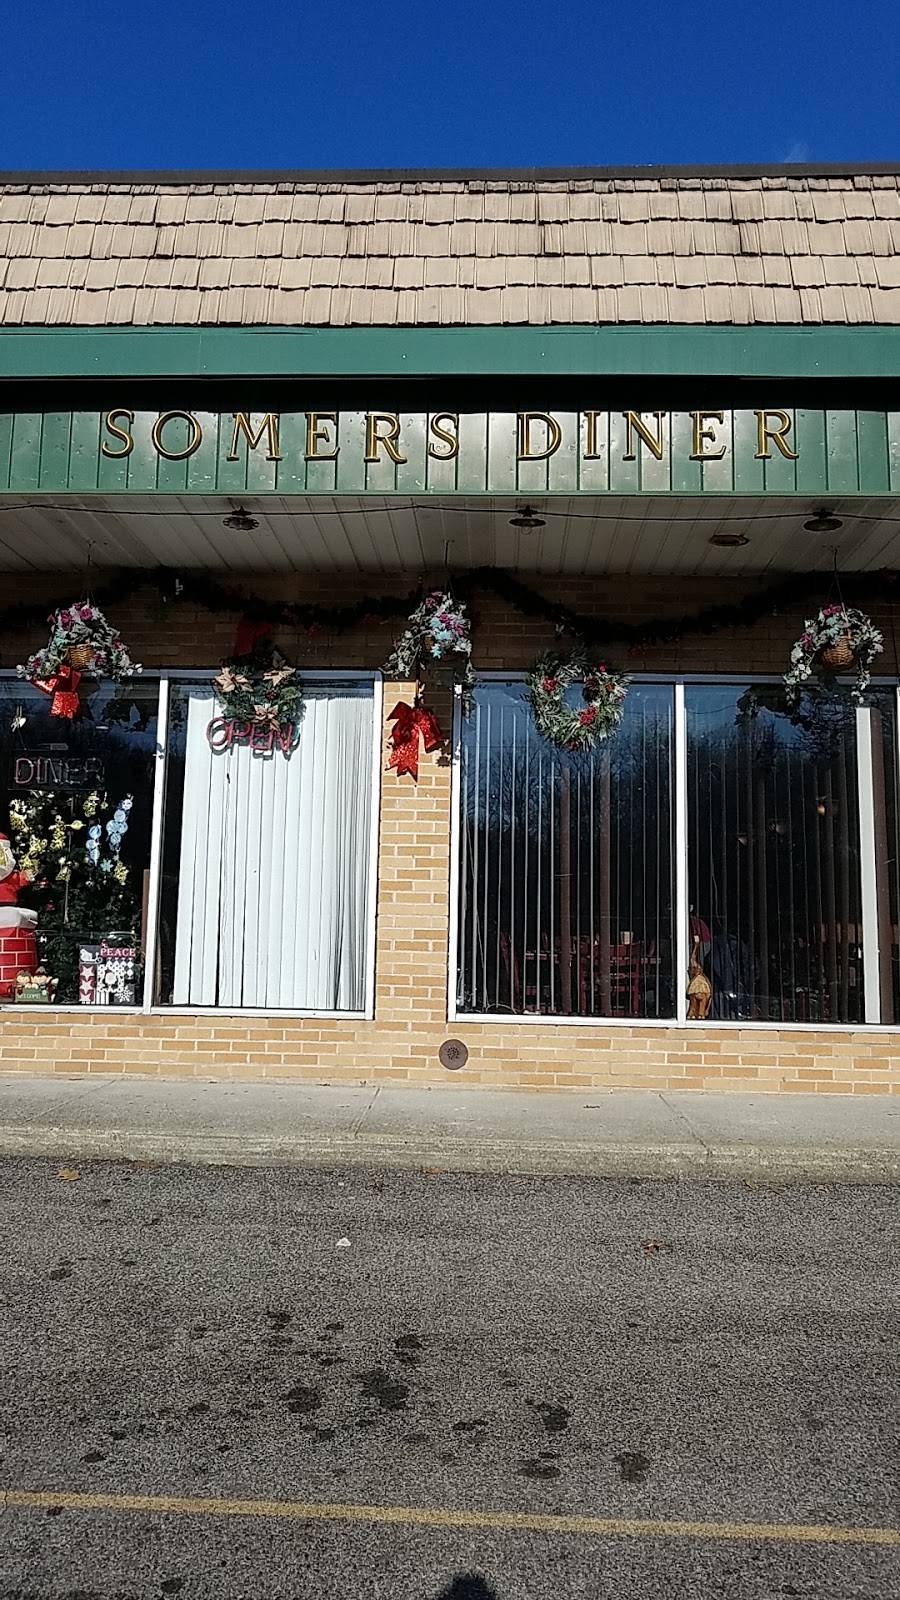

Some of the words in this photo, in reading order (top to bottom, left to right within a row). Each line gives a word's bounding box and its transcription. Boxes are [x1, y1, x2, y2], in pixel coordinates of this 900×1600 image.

[101, 408, 460, 463] SOMERS
[516, 409, 800, 461] DINER
[206, 716, 293, 752] OPEN
[15, 757, 105, 784] DINER
[100, 947, 136, 957] PEACE
